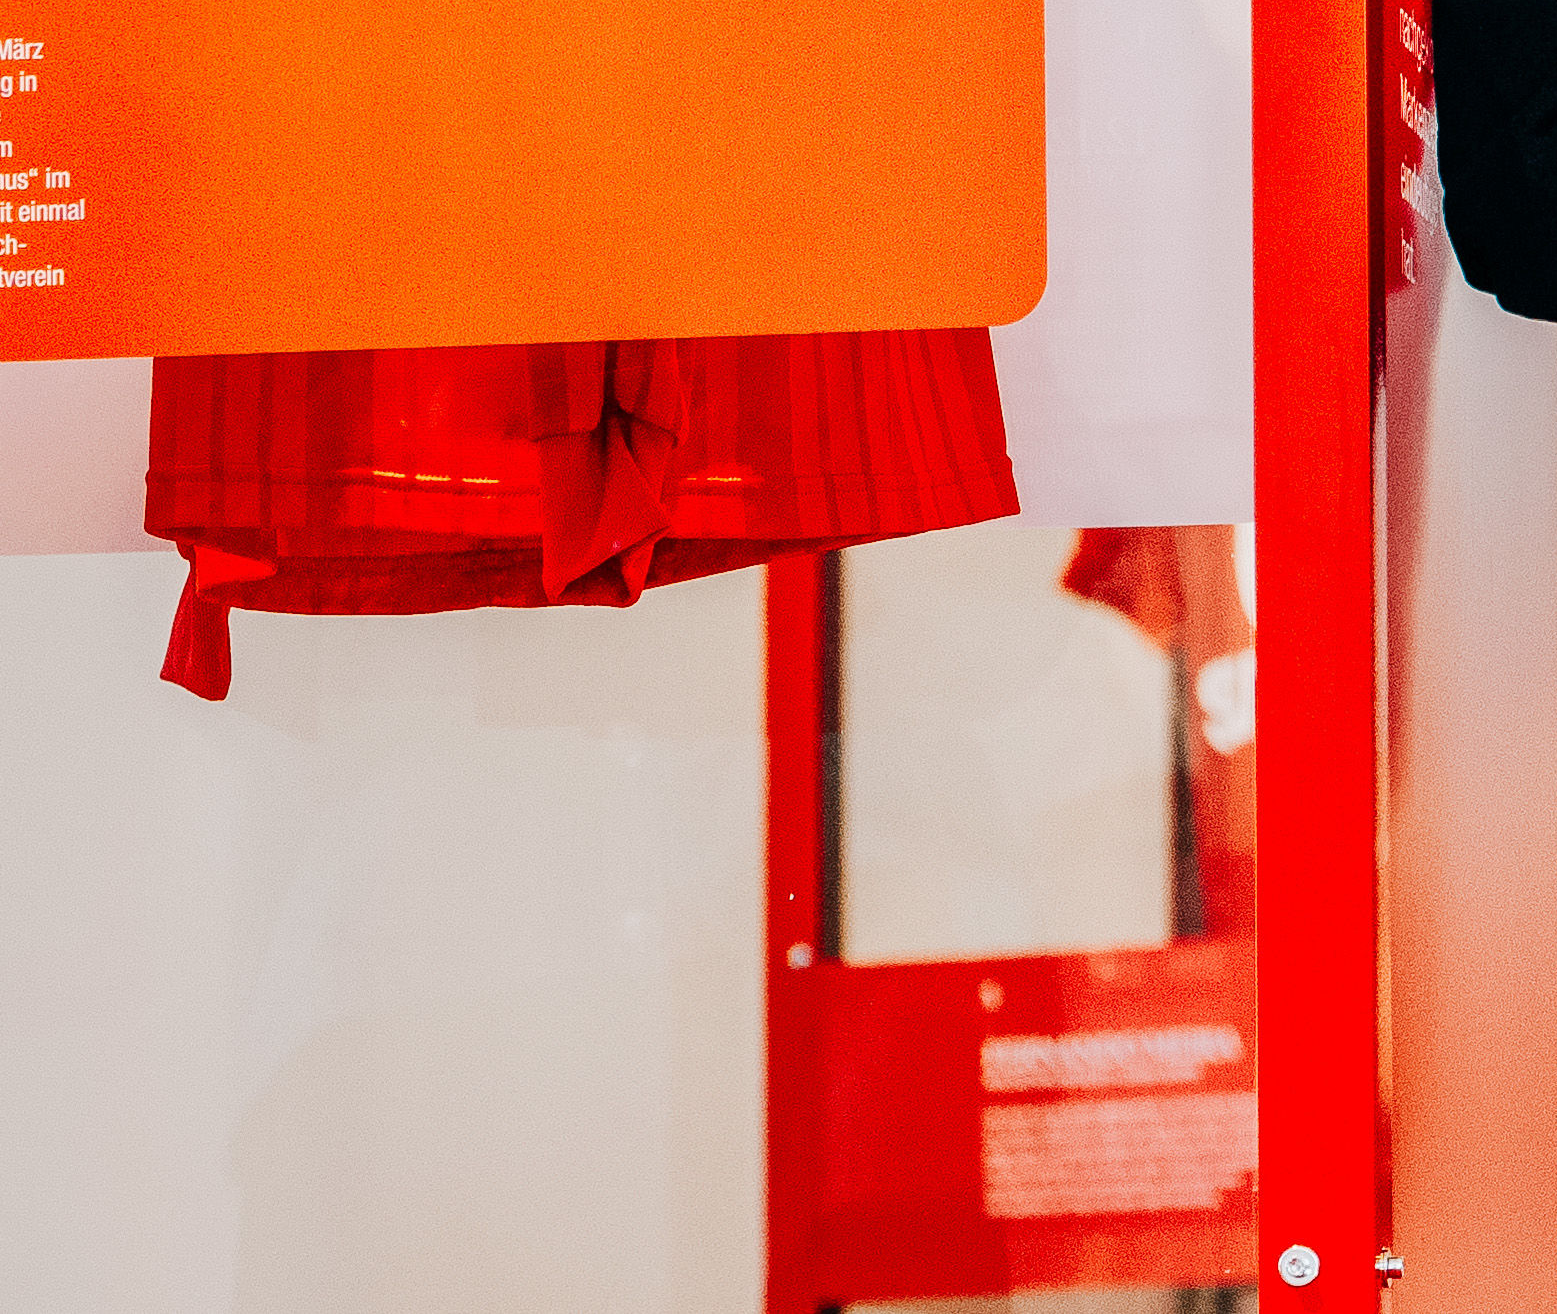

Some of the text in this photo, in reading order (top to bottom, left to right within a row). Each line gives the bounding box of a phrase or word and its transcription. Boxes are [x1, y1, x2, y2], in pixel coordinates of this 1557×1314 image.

[19, 70, 37, 92] in
[45, 167, 71, 189] im
[18, 198, 85, 222] einmal
[1400, 225, 1415, 286] hat.
